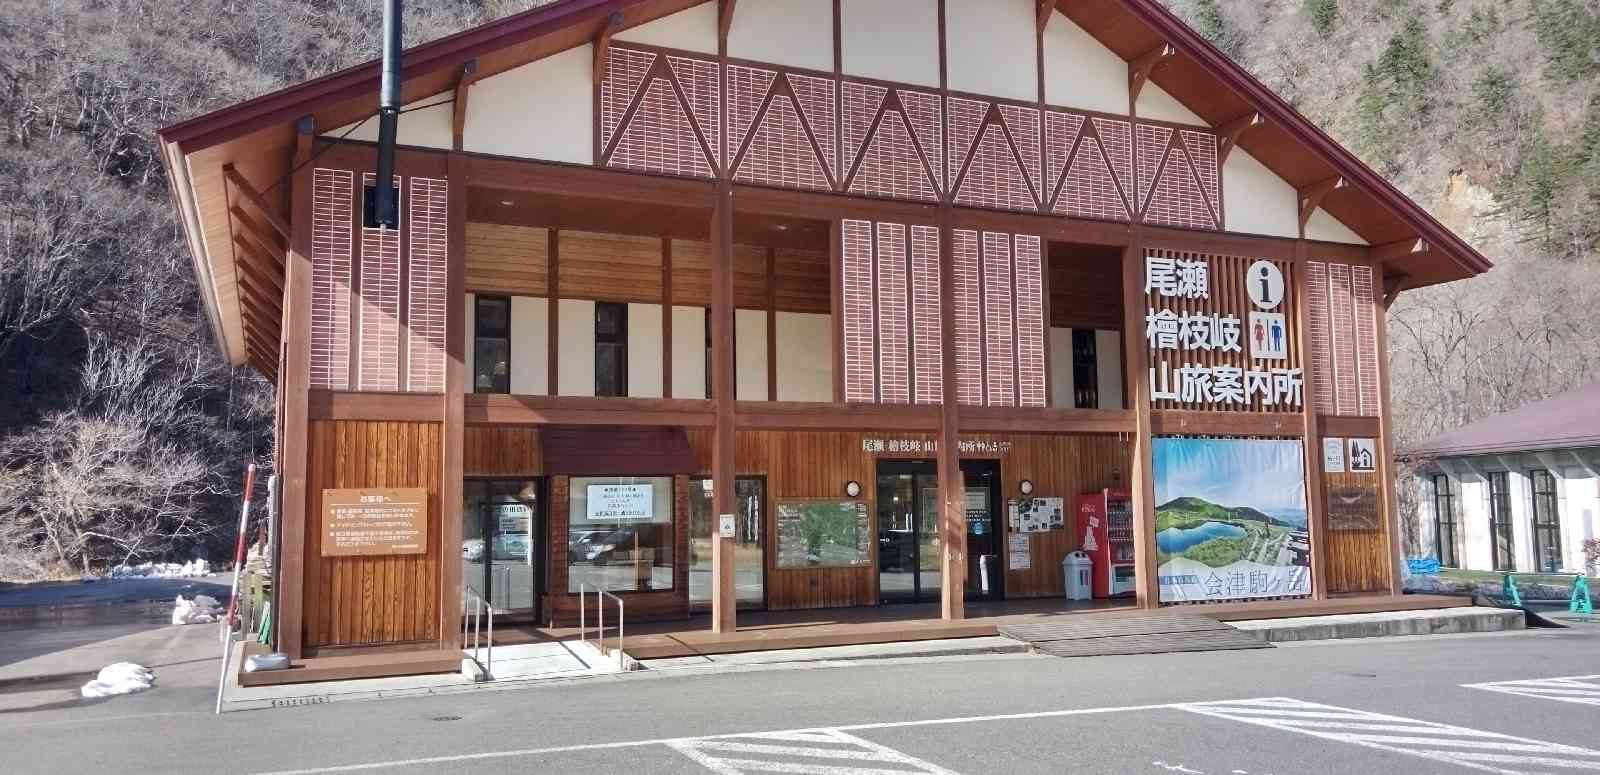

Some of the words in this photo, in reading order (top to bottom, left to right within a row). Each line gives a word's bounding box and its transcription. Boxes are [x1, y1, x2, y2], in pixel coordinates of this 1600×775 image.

[1145, 257, 1209, 299] 尾瀬
[1146, 308, 1242, 352] 檜枝岐
[1149, 360, 1303, 407] 山旅案内所
